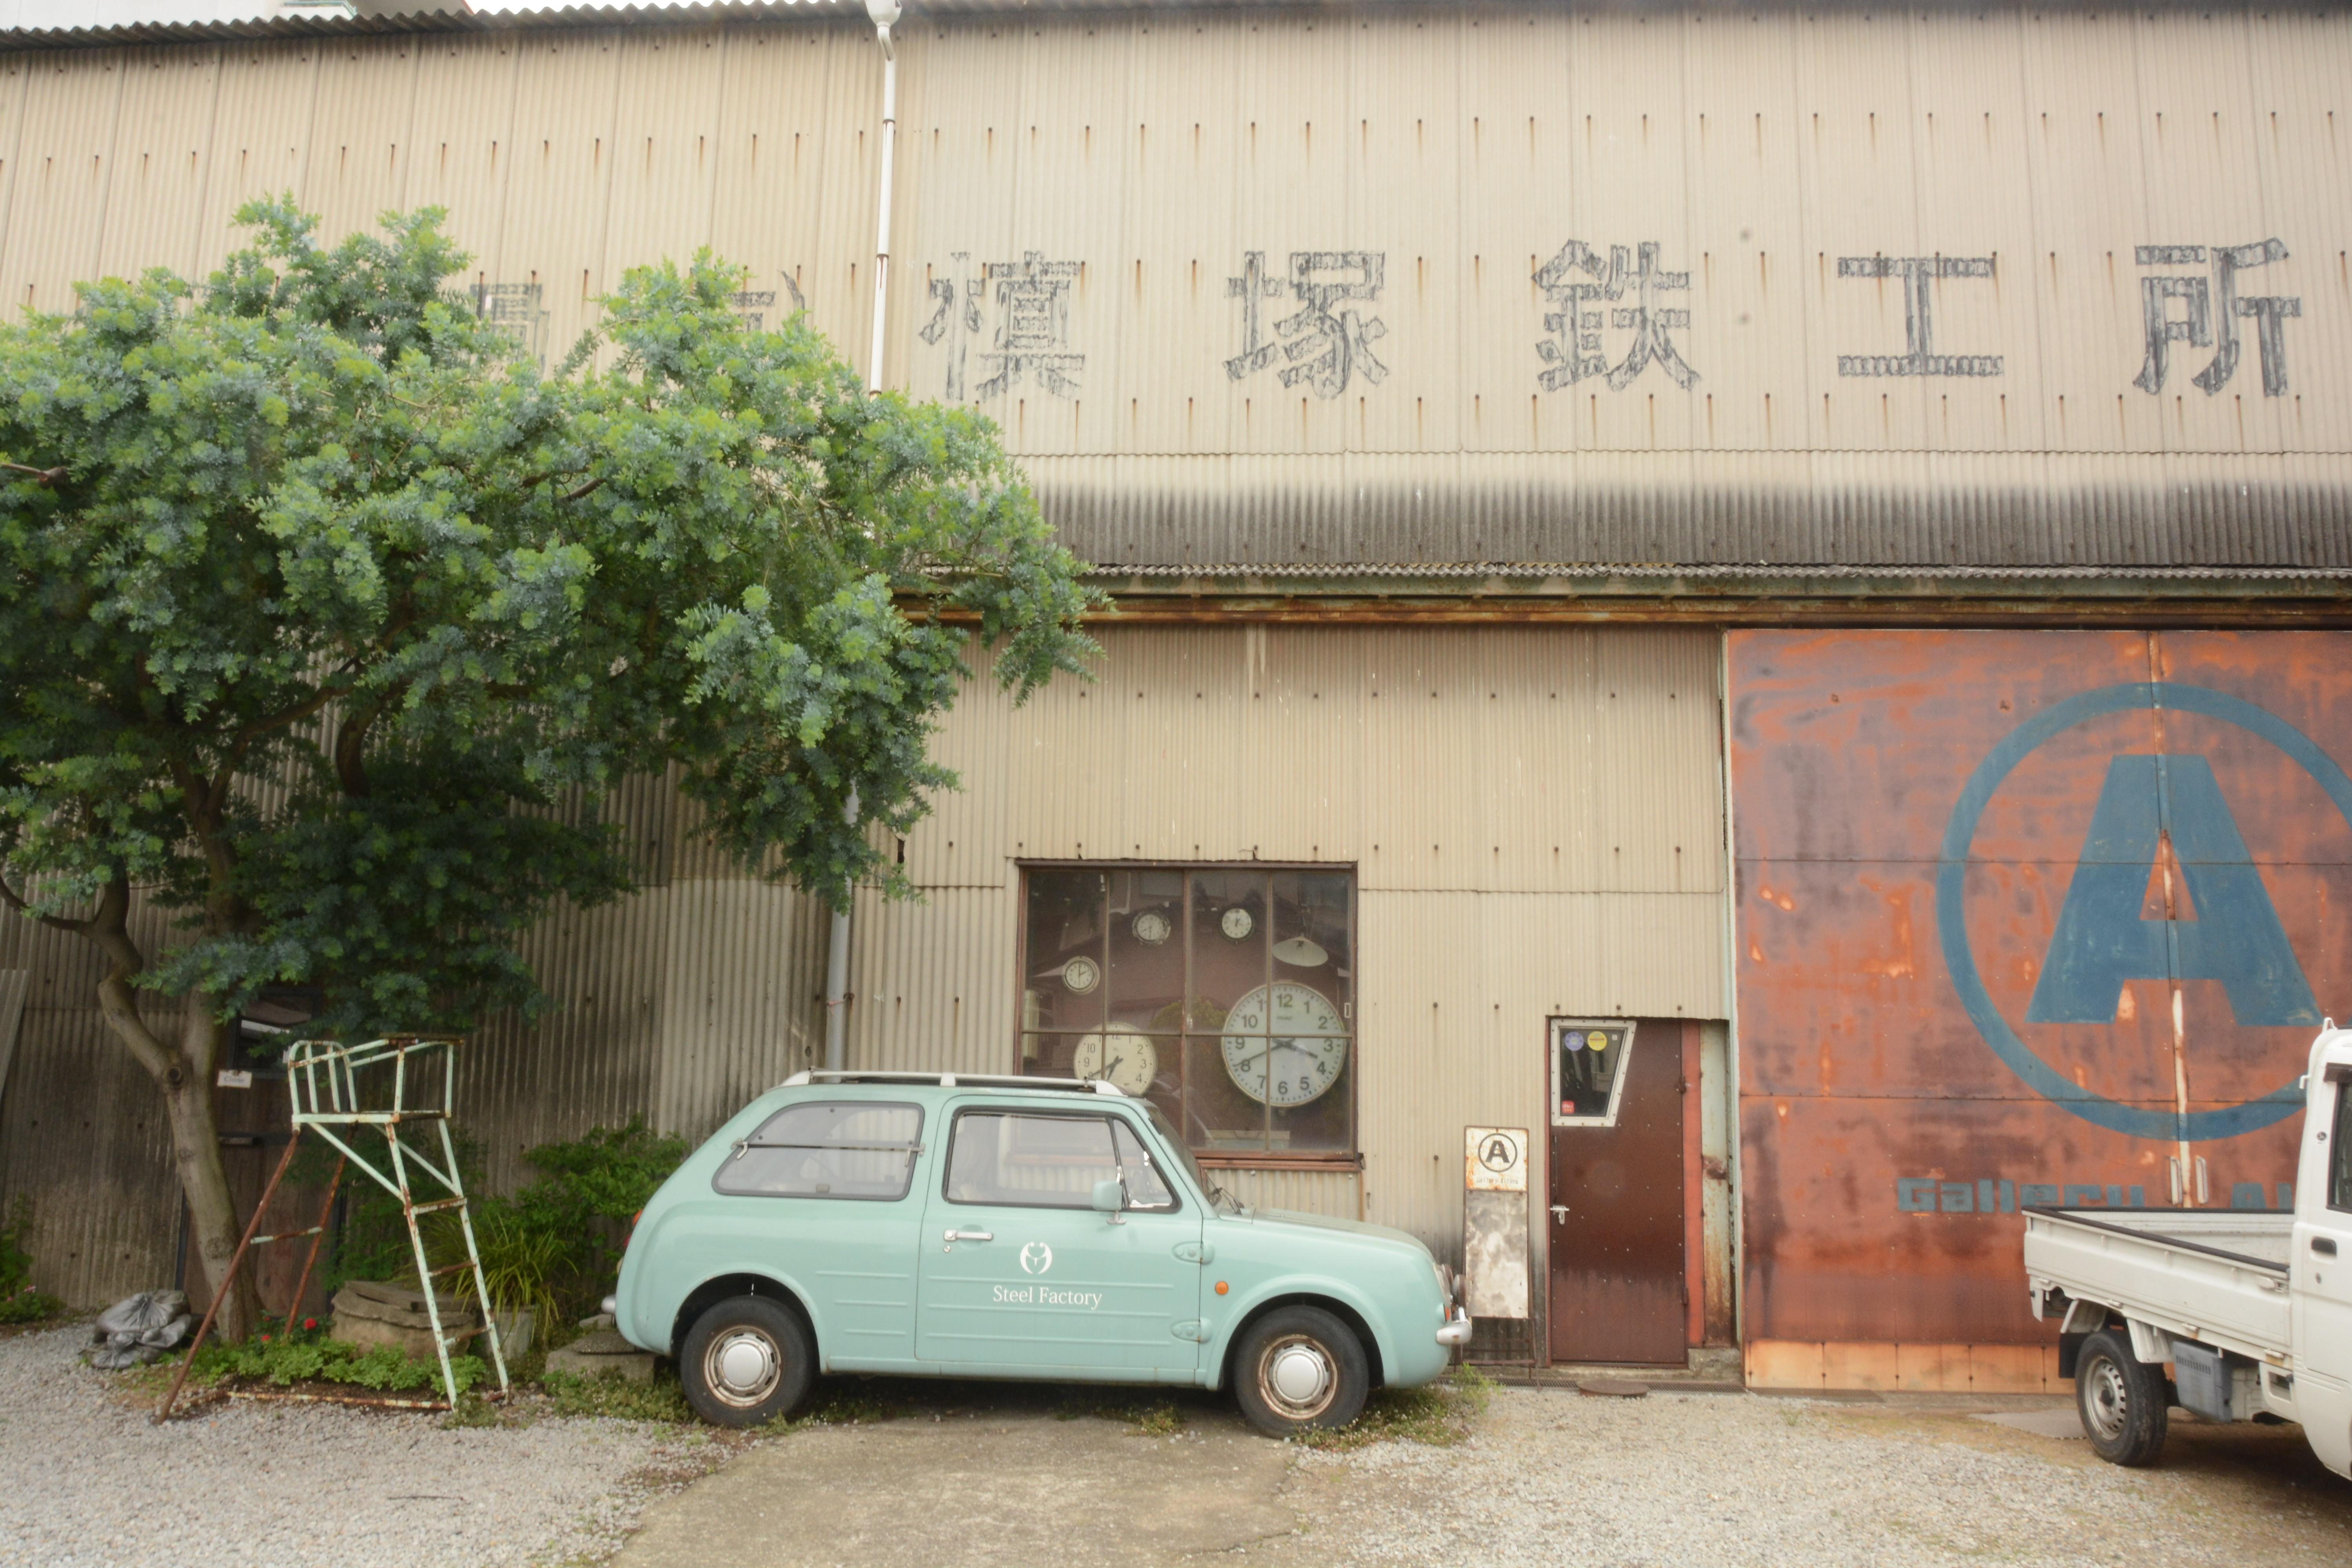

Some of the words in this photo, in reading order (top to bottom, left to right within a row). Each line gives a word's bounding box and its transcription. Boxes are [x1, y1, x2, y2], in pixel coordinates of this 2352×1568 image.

[2025, 755, 2323, 1026] A
[1276, 993, 1293, 1008] 12
[1304, 1000, 1310, 1014] 1
[1242, 1014, 1258, 1028] 10
[1318, 1016, 1327, 1029] 2
[1087, 1044, 1095, 1053] 10
[1138, 1045, 1143, 1054] 2
[1235, 1037, 1245, 1049] 9
[1323, 1038, 1333, 1052] 3
[1084, 1058, 1090, 1067] 9
[1141, 1059, 1146, 1068] 3
[1241, 1059, 1250, 1072] 8
[1316, 1061, 1326, 1075] 4
[1136, 1074, 1142, 1083] 4
[1257, 1075, 1267, 1089] 7
[1299, 1076, 1310, 1090] 5
[1278, 1081, 1288, 1095] 6
[1485, 1140, 1510, 1163] A
[993, 1285, 1033, 1303] Steel
[1039, 1287, 1103, 1310] Factory
